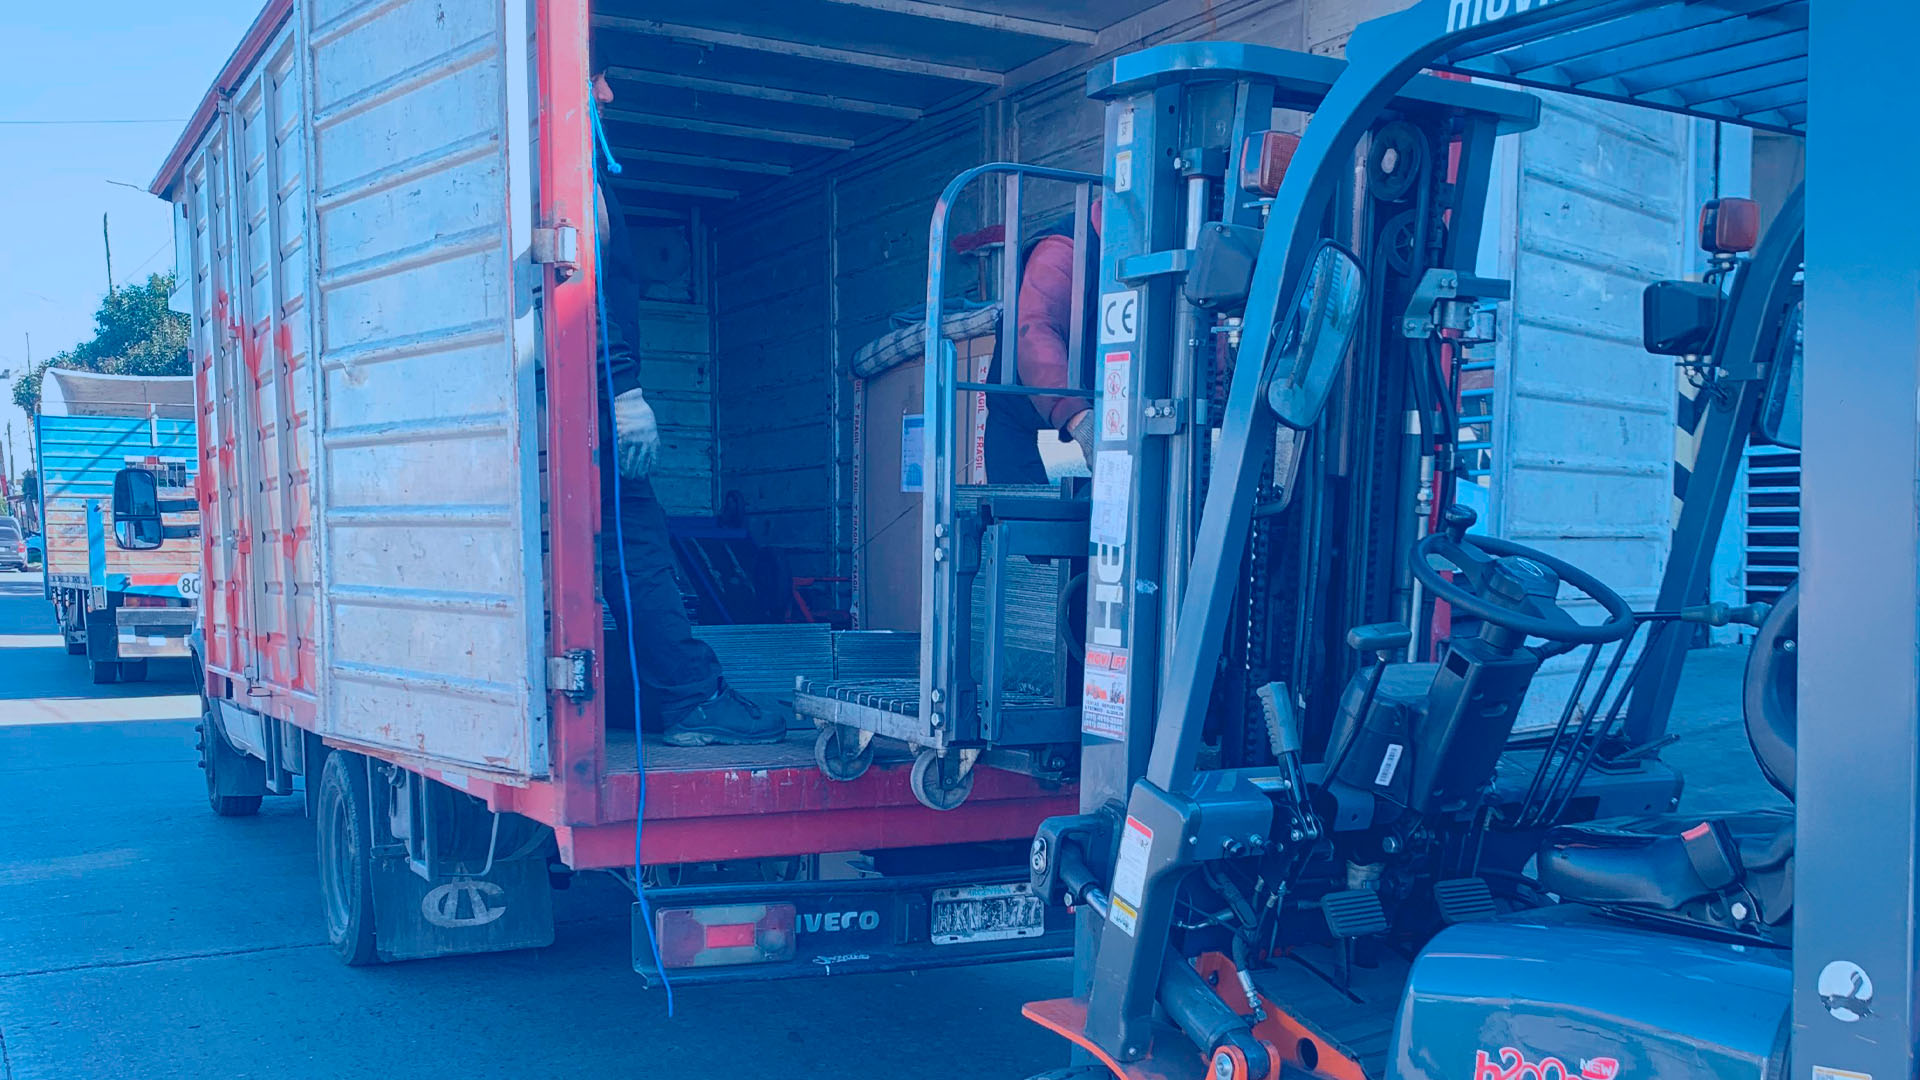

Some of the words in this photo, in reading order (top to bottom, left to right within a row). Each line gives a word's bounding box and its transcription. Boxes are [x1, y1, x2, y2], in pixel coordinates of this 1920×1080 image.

[977, 379, 986, 415] FAGIL
[976, 436, 985, 470] FRAGIL
[1580, 1058, 1614, 1077] NEW
